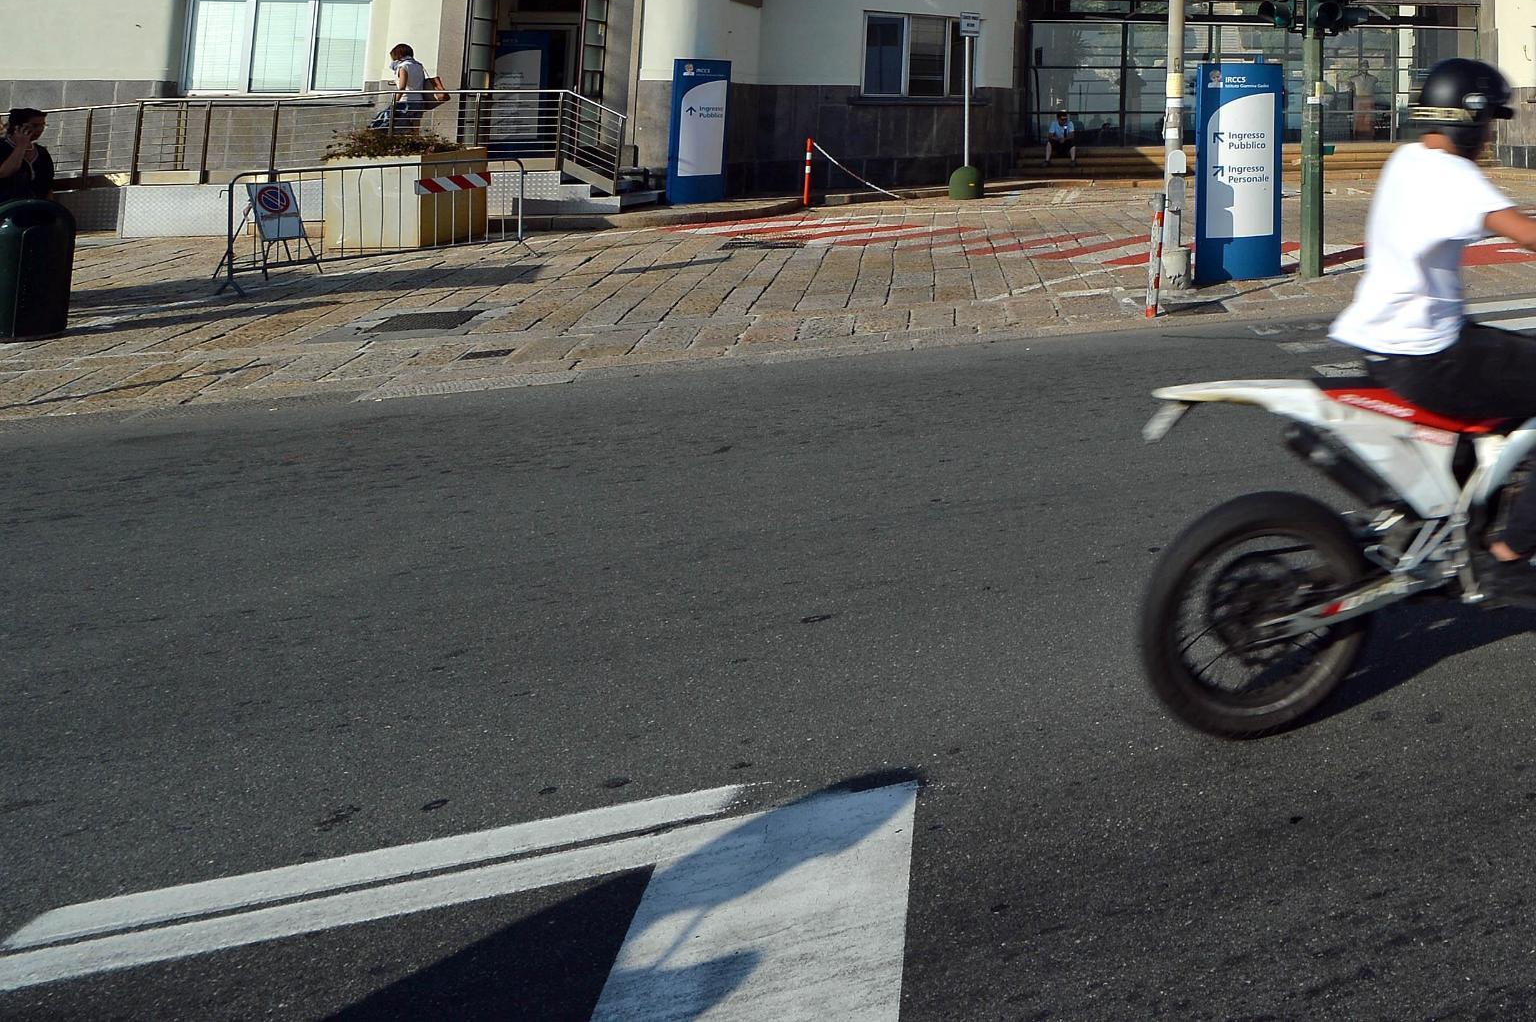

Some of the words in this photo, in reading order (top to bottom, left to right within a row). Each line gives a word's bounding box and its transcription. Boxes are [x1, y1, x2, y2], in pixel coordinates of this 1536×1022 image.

[1228, 131, 1266, 141] Ingresso
[1228, 141, 1266, 149] Pubblico
[1228, 165, 1265, 175] Ingresso
[1228, 174, 1270, 183] Personale
